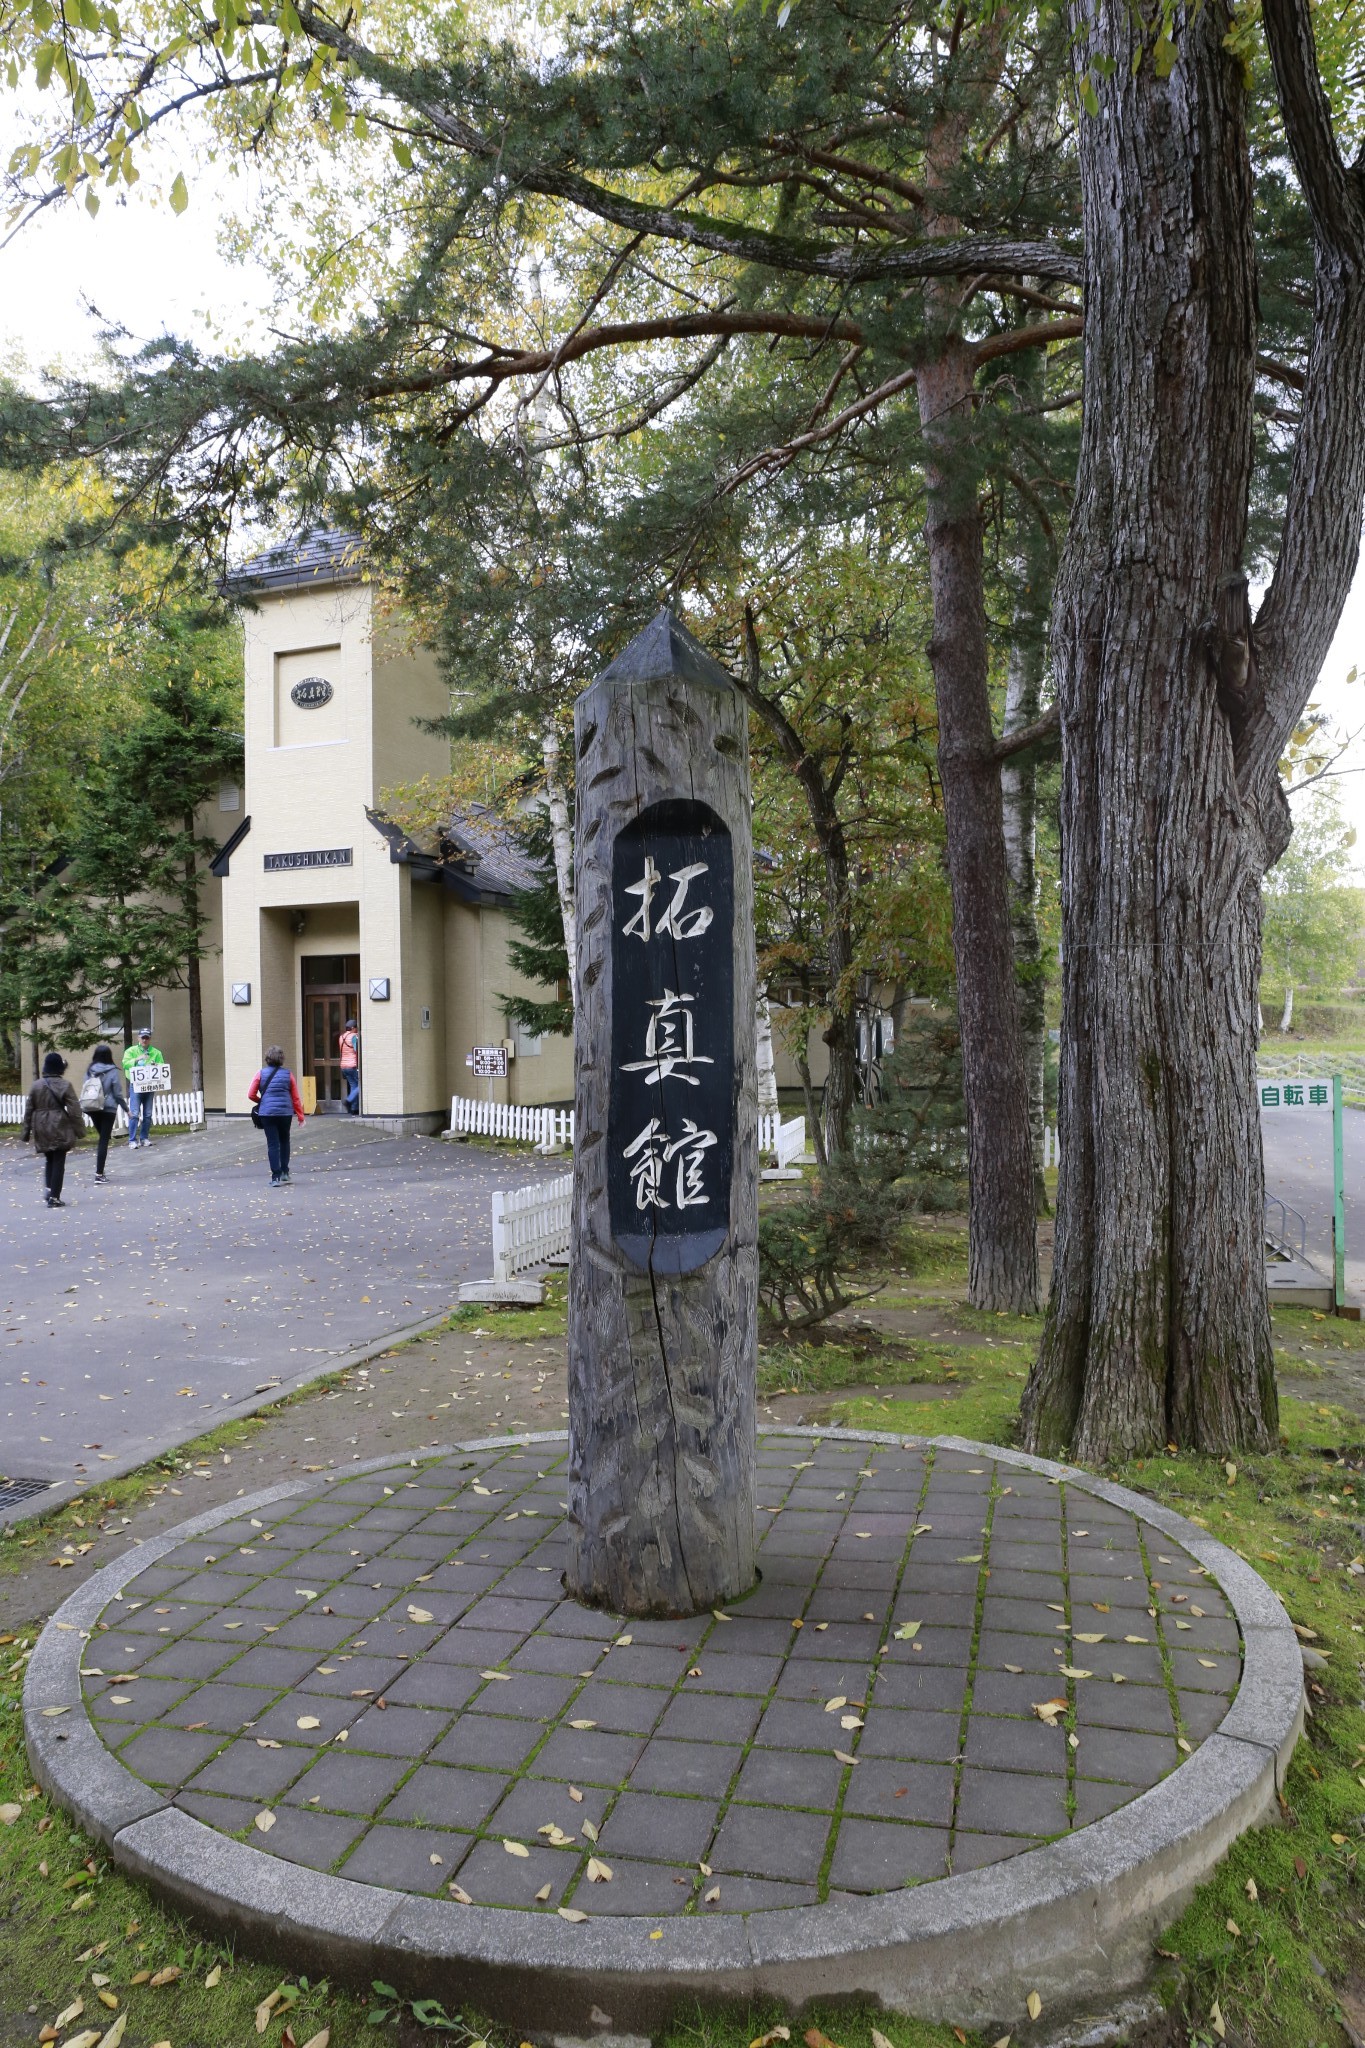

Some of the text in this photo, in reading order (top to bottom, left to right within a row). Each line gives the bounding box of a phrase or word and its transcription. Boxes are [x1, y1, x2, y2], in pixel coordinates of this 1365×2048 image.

[269, 851, 346, 868] TAKUSHINKAN
[619, 855, 719, 1211] 拓真館
[1261, 1085, 1328, 1106] 自転車
